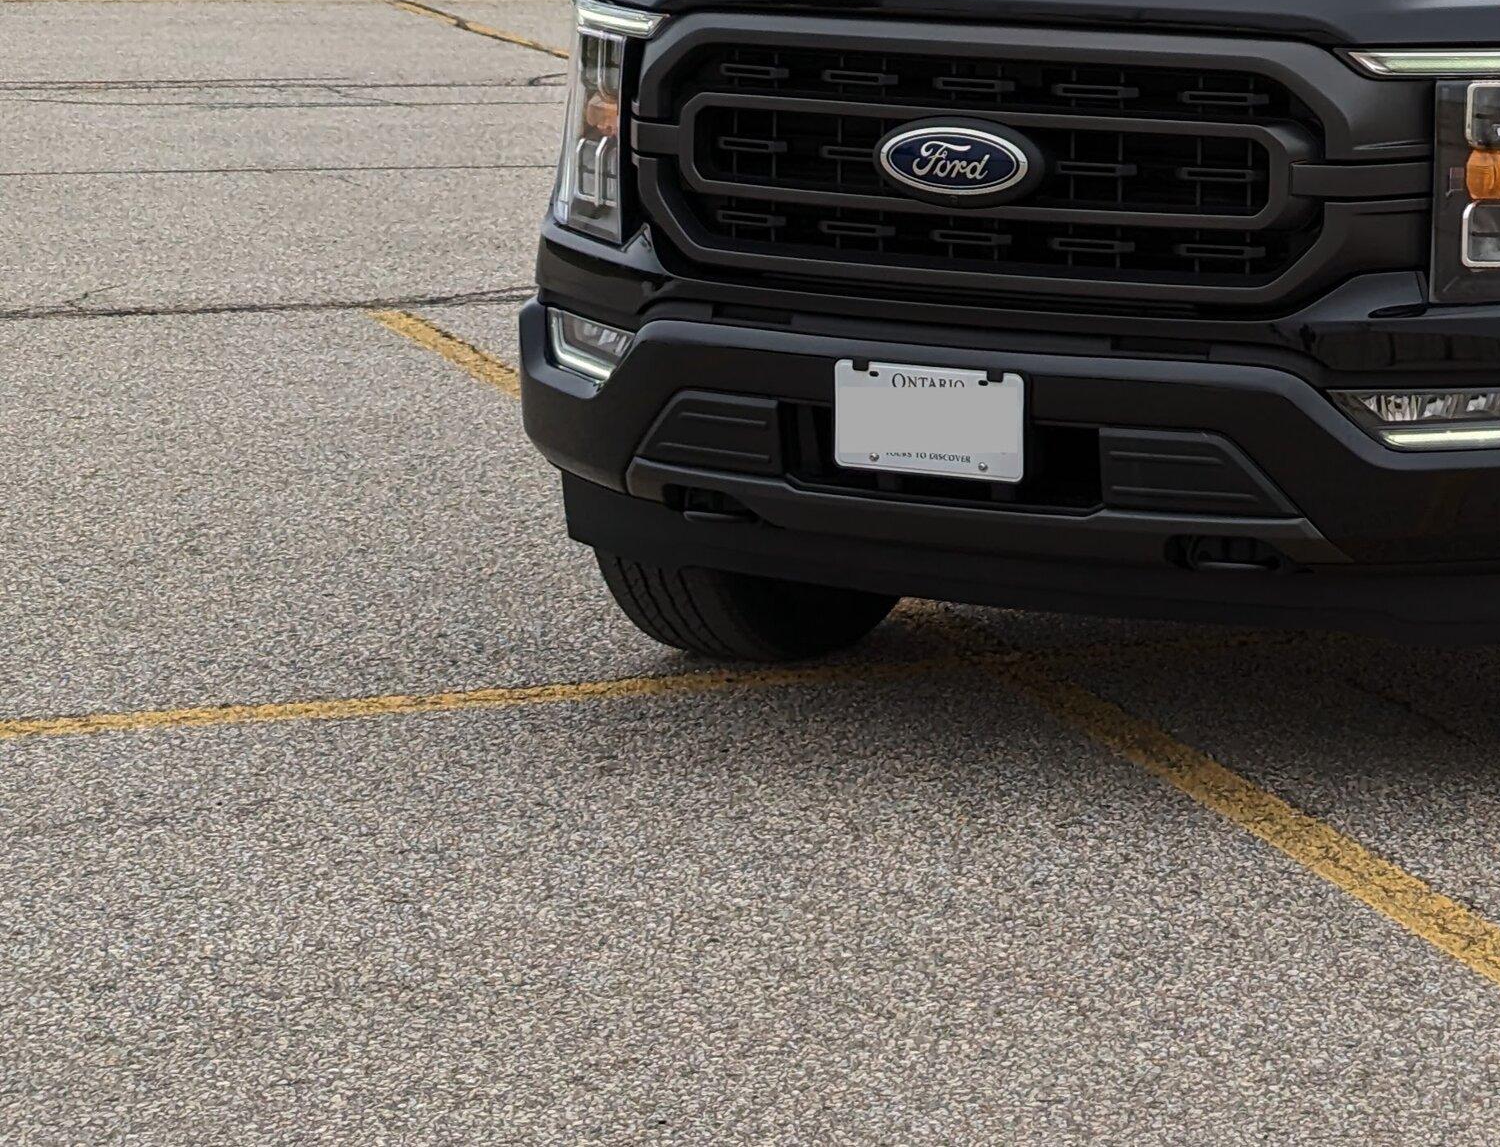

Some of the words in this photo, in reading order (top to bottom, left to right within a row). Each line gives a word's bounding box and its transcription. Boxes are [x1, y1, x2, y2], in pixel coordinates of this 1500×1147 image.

[912, 140, 991, 181] Ford
[891, 372, 966, 388] ONTARIO
[915, 452, 927, 460] TO
[929, 453, 971, 463] DISCOVER
